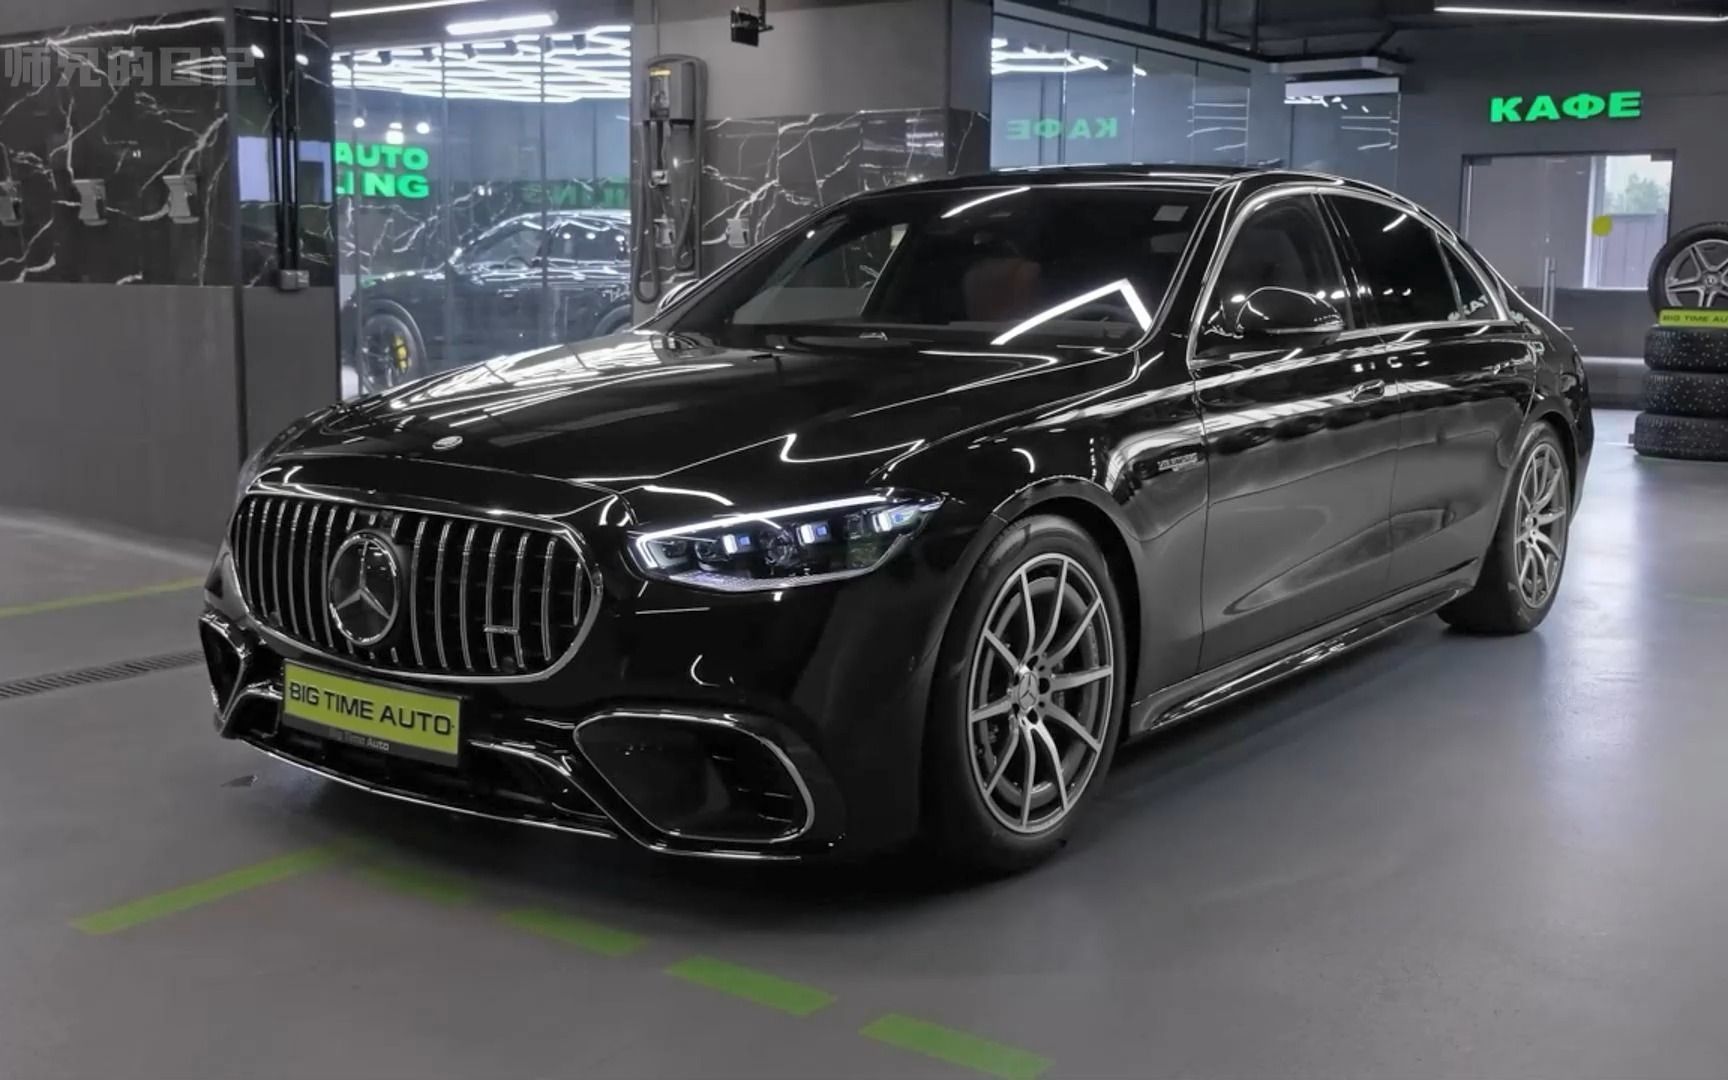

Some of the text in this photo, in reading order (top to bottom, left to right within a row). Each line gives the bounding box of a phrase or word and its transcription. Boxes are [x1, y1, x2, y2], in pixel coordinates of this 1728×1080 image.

[1490, 91, 1642, 123] КАФЕ
[1684, 314, 1709, 322] TIME
[289, 681, 451, 736] BIG TIME AUTO
